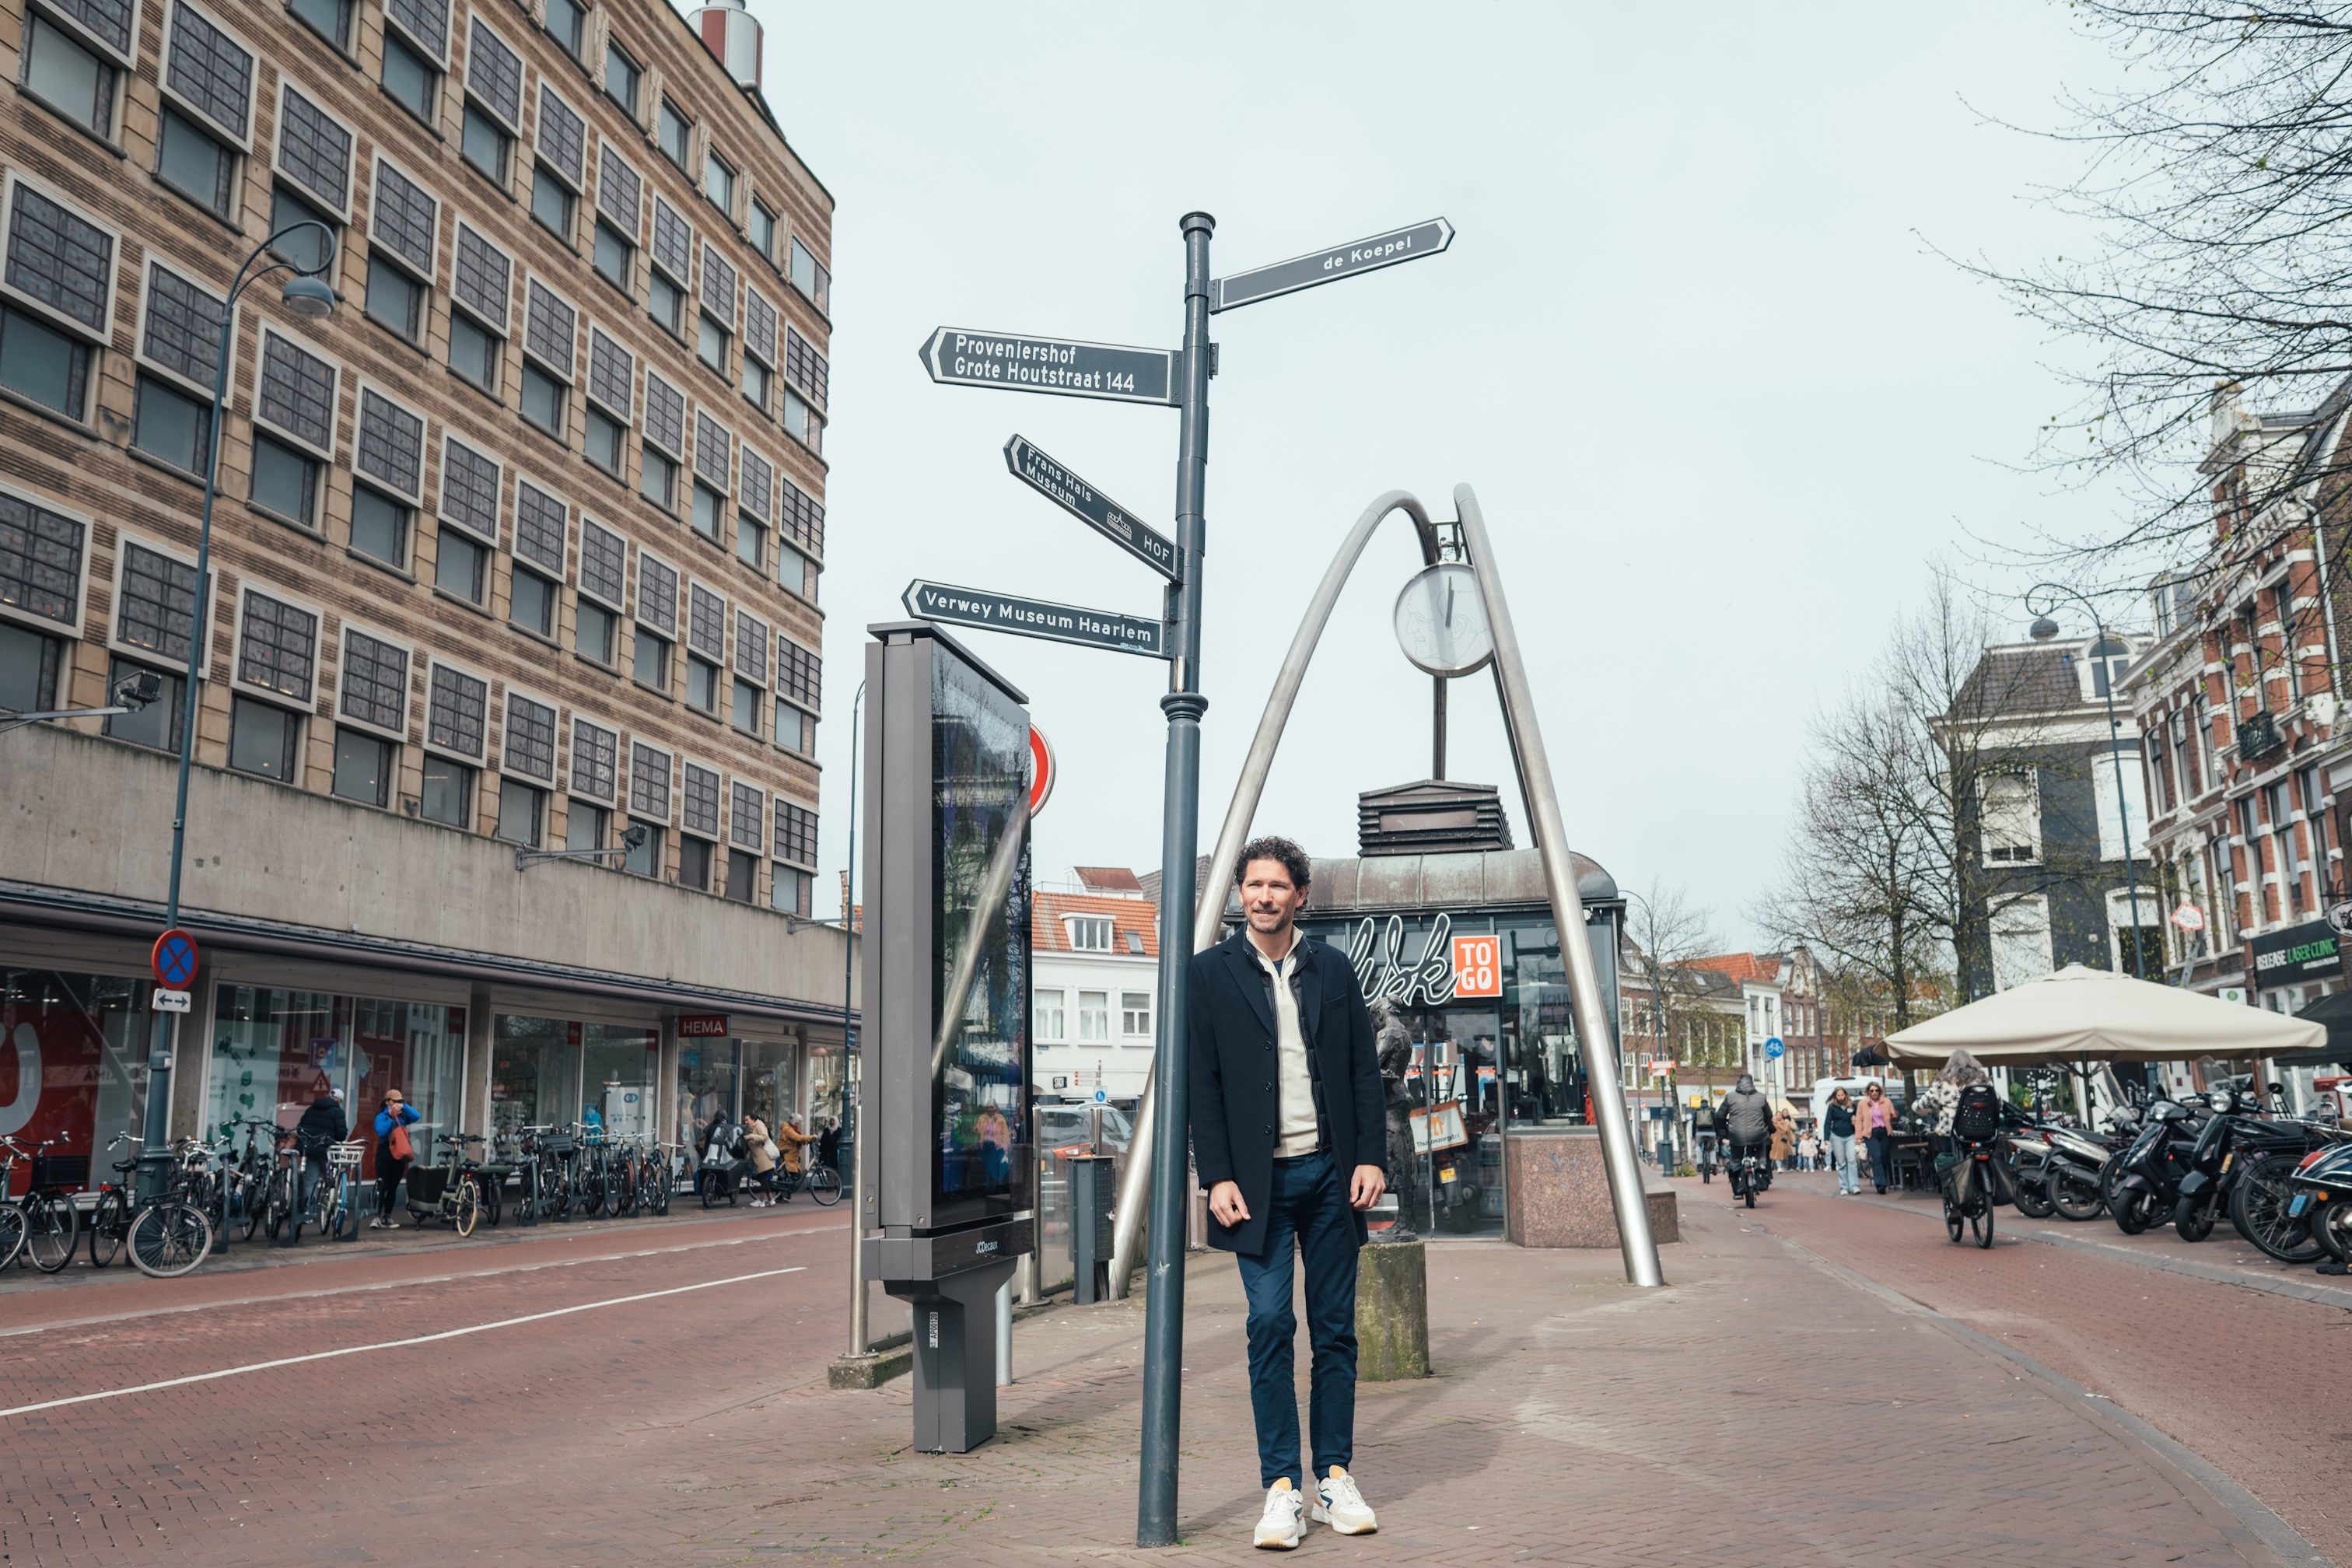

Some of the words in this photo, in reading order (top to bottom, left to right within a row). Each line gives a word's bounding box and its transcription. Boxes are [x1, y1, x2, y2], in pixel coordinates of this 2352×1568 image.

[1324, 257, 1343, 270] de
[1352, 236, 1411, 263] Koepel
[955, 334, 1076, 364] Proveniershof
[955, 356, 1000, 379] Grote
[1007, 362, 1101, 388] Houtstraat
[1106, 371, 1135, 392] 144
[1026, 462, 1076, 506] Museum
[1027, 447, 1062, 481] Frans
[1066, 474, 1091, 502] Hals
[1144, 534, 1170, 561] HOF
[926, 590, 992, 618] Verwey
[999, 604, 1073, 629] Museum
[1079, 617, 1152, 642] Haarlem
[1460, 943, 1492, 966] TO
[2256, 950, 2287, 971] RELEASE
[2287, 944, 2312, 964] LASER
[1461, 967, 1493, 990] GO
[683, 1020, 723, 1034] HEMA
[1416, 1132, 1460, 1147] Thuibezorgd.nl
[975, 1241, 999, 1255] JCDecaux
